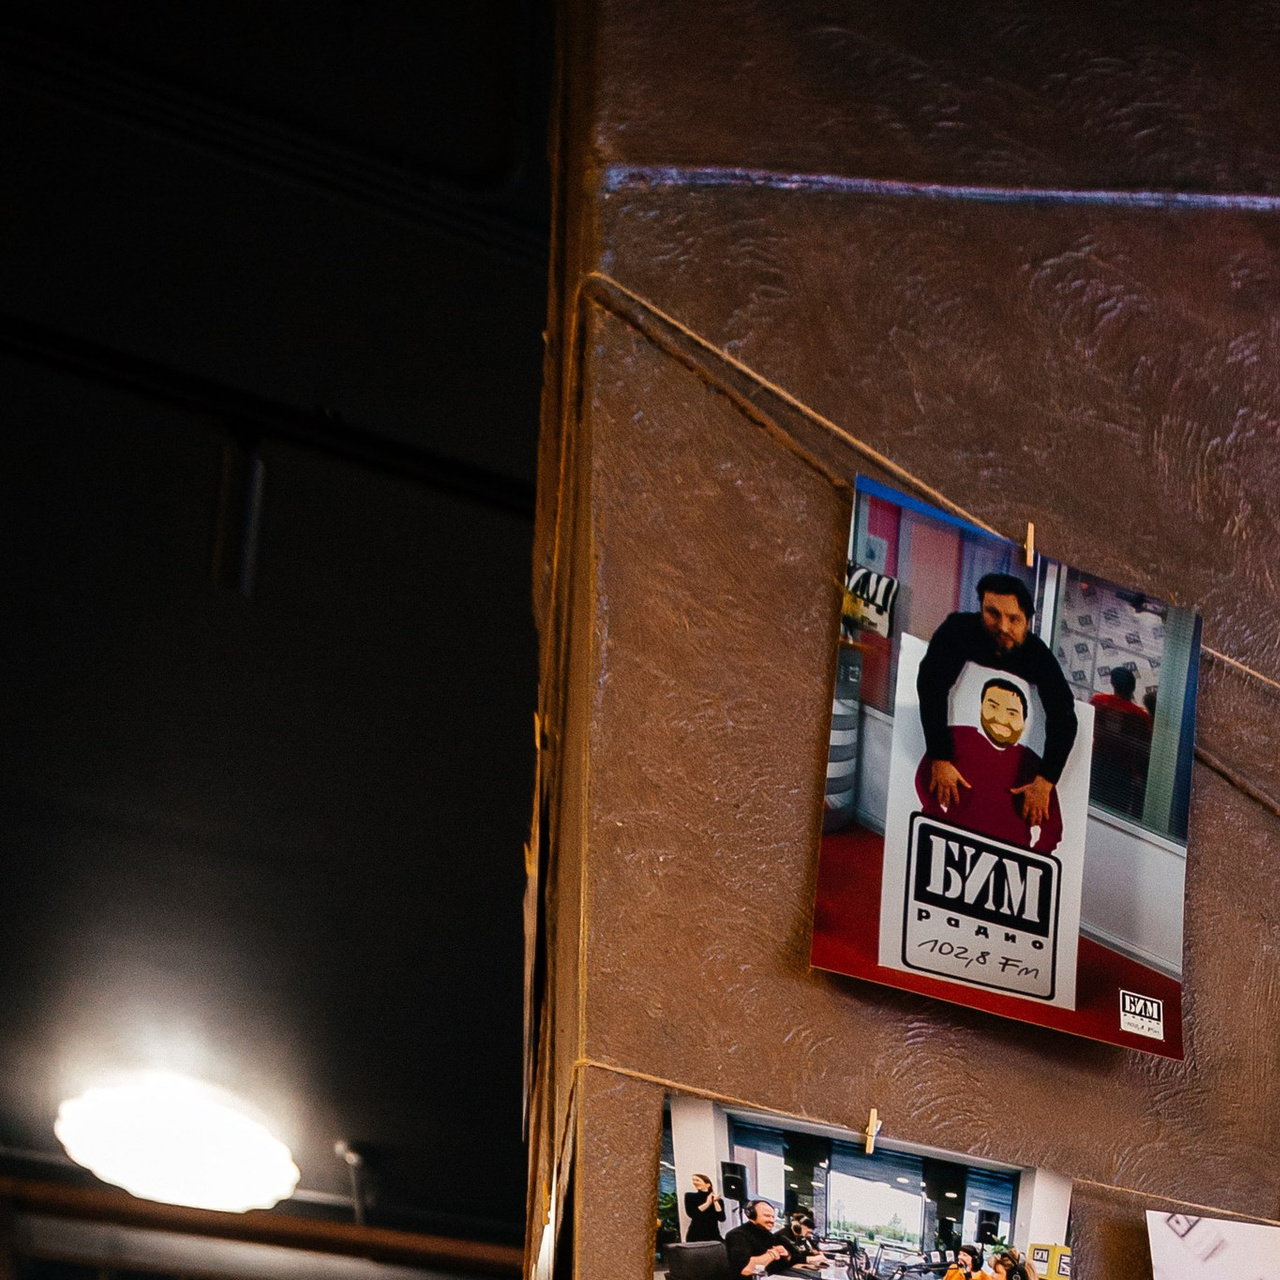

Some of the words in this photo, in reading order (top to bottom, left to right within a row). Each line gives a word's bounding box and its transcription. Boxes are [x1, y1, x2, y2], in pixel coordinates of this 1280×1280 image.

[926, 834, 1043, 923] БИМ
[917, 908, 1045, 950] радио
[917, 939, 991, 969] 102,8
[1124, 994, 1159, 1020] БИМ
